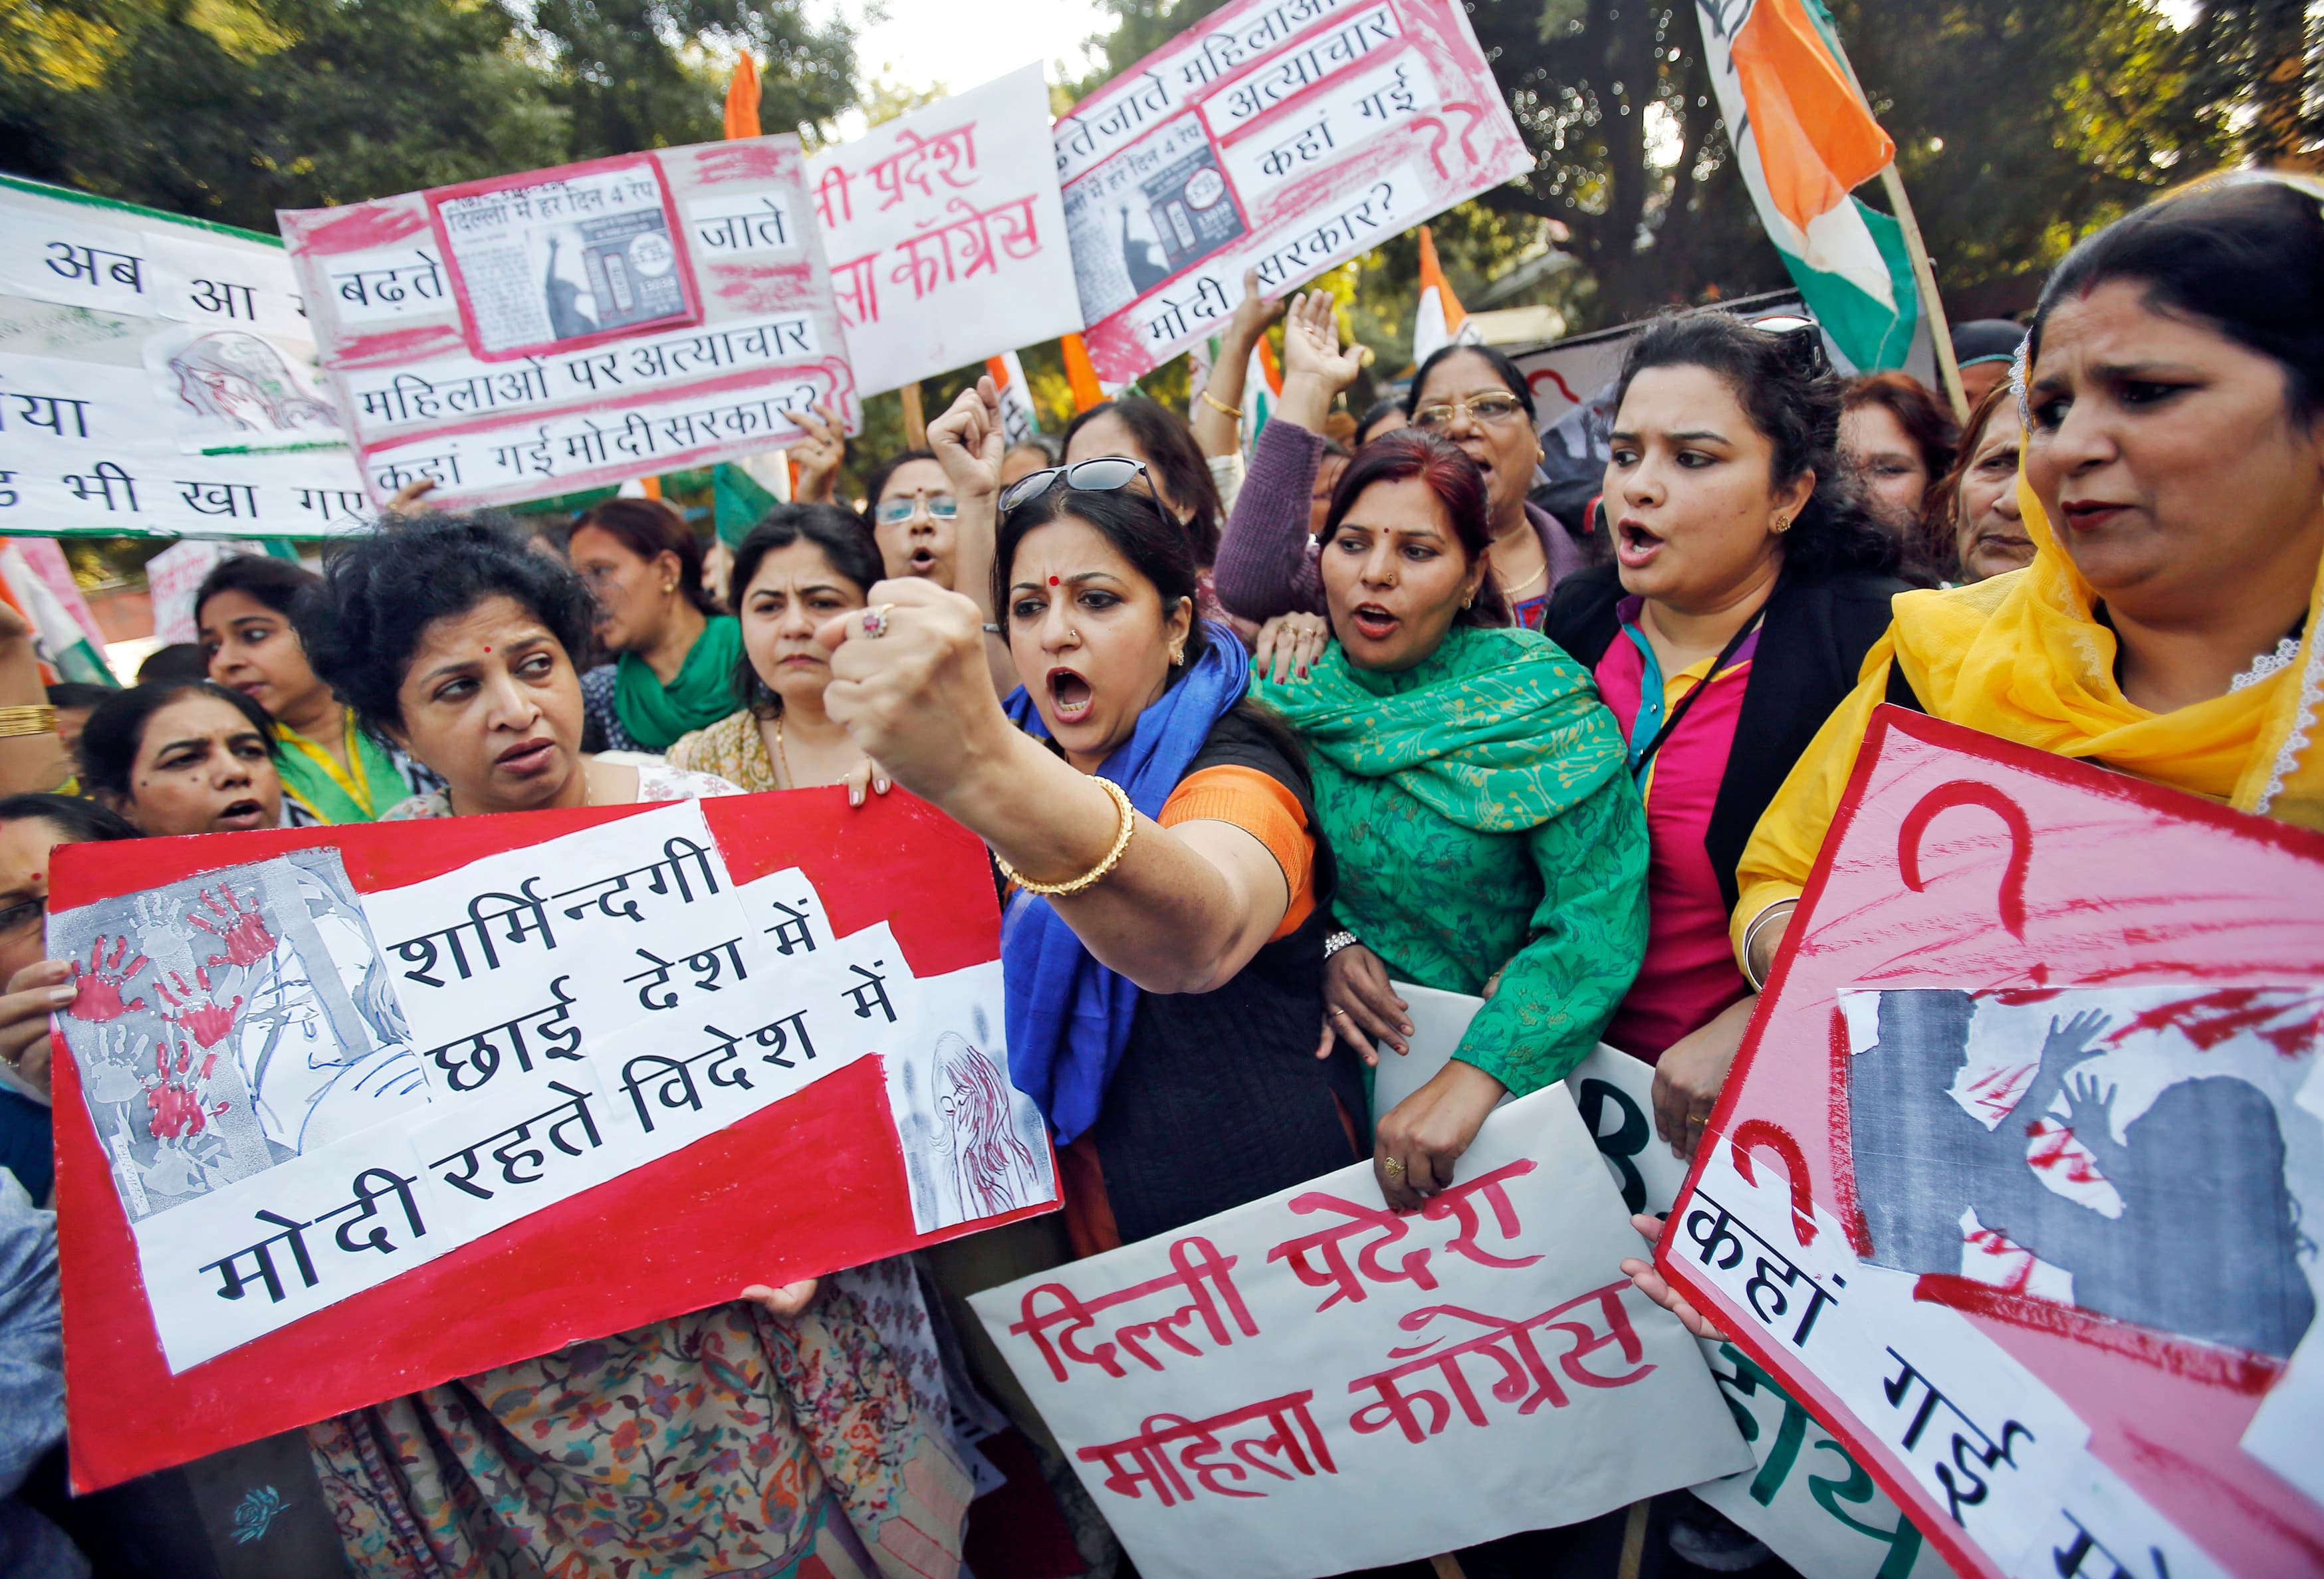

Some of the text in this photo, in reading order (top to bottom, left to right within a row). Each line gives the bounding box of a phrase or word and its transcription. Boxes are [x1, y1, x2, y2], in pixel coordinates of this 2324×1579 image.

[1098, 71, 1170, 135] जाते
[1227, 10, 1399, 121] अत्याचार
[1256, 108, 1336, 179] कहां
[1353, 62, 1419, 122] गई
[866, 120, 984, 211] प्रदेश
[332, 250, 444, 311] बढ़ते
[693, 198, 788, 253] जाते
[1146, 276, 1230, 342] मोदी
[1253, 181, 1393, 288] सरकार?
[45, 242, 146, 294] अब
[191, 278, 257, 322] आ
[356, 318, 812, 421] महिलाओं पर अत्याचार
[368, 383, 816, 490] कहां गई मोदी सरकार?
[63, 461, 140, 512] भी
[174, 480, 259, 519] खा
[290, 487, 368, 526] गए
[386, 835, 720, 988] शर्मिन्दगी
[423, 898, 816, 1092] छाई देश में
[199, 960, 898, 1304] मोदी रहते विदेश में
[1008, 1158, 1547, 1383] दिल्ली प्रदेश
[1685, 1187, 1848, 1348] कहां
[1883, 1346, 2036, 1527] गई
[1077, 1388, 1339, 1509] महिला
